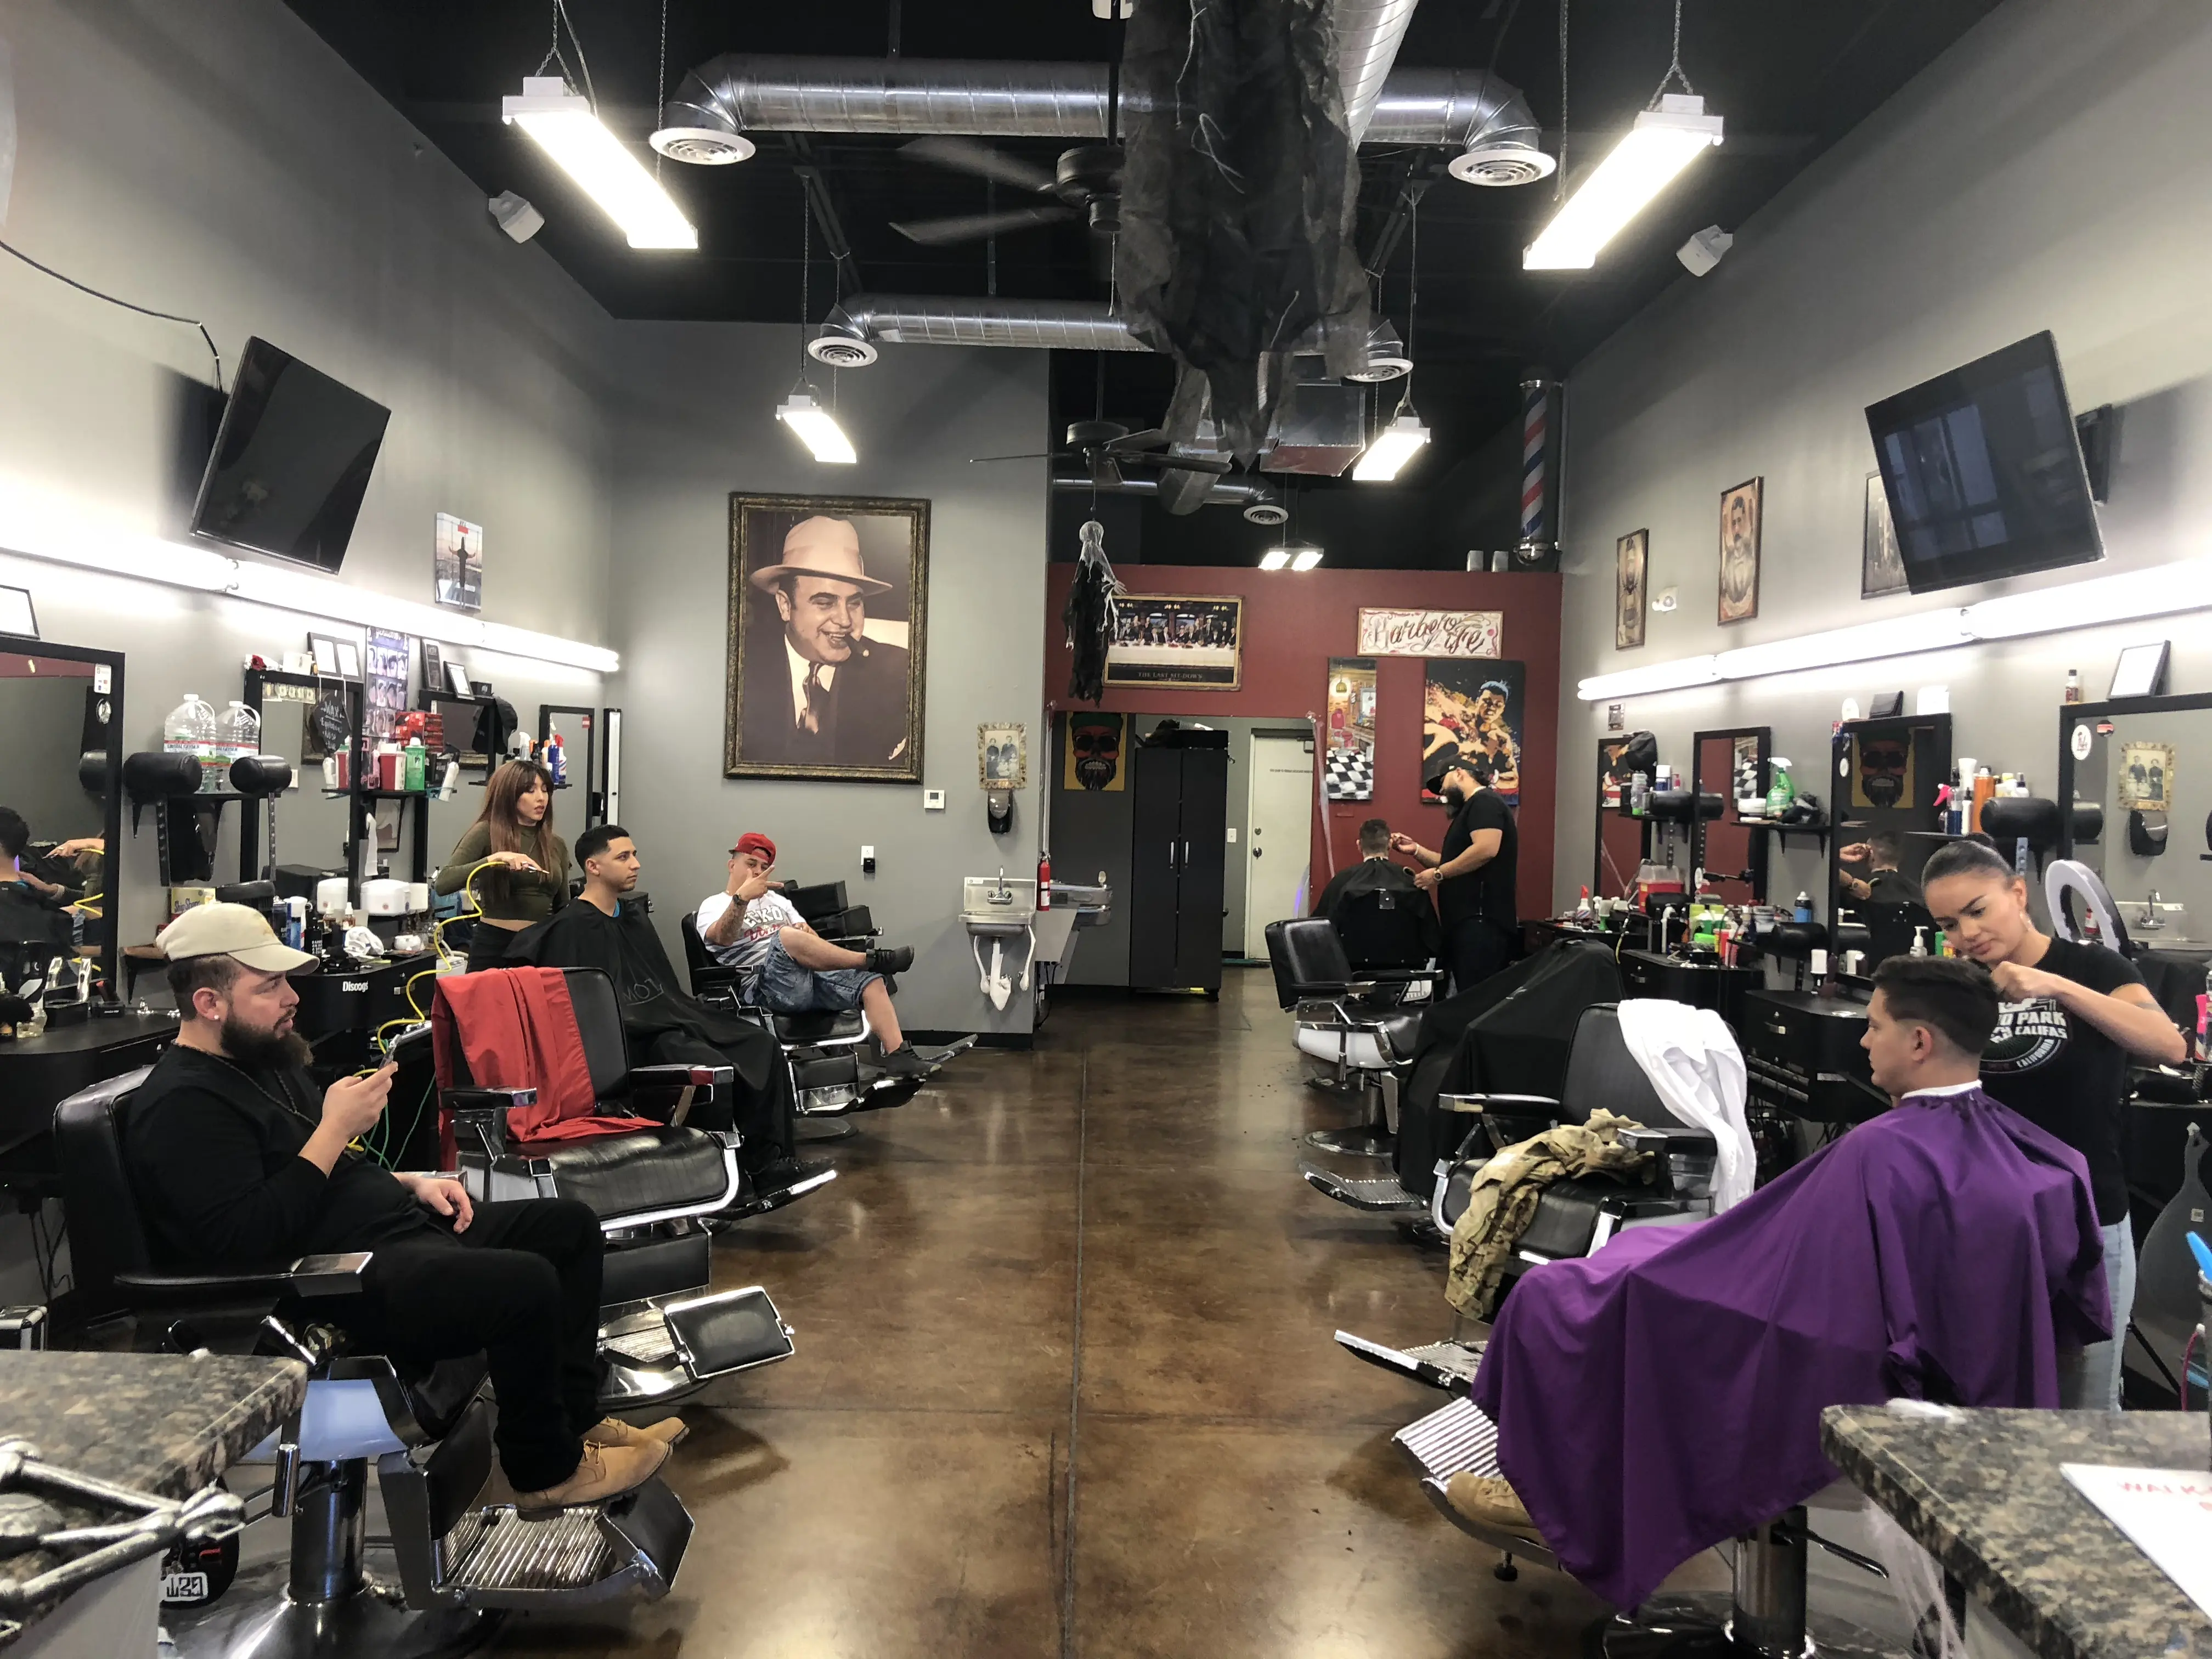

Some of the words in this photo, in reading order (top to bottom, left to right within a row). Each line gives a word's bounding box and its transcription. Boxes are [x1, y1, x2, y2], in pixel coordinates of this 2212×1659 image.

[342, 980, 369, 992] Discogs
[2016, 1011, 2067, 1026] PARK
[2015, 1025, 2068, 1039] CALIFAS
